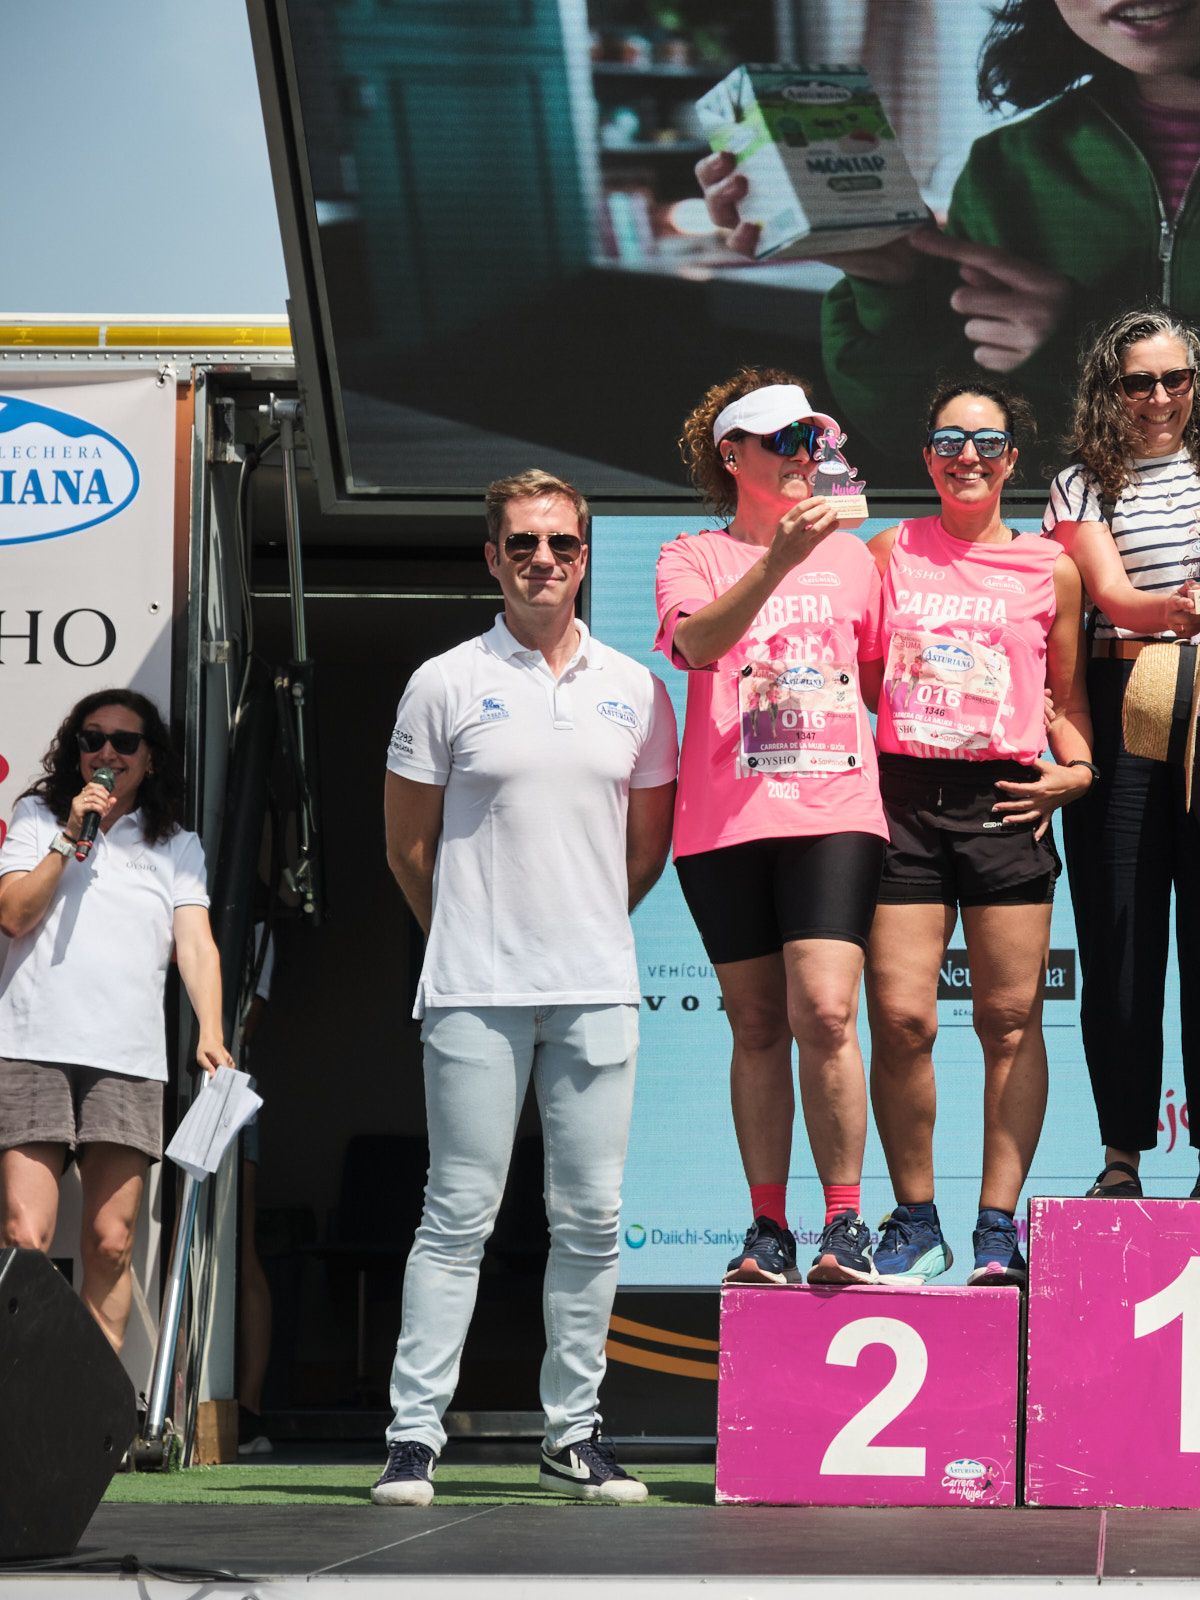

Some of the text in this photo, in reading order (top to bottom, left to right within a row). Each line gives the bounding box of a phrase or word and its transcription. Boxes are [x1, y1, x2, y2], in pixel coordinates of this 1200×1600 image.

[916, 685, 961, 708] 016
[925, 706, 945, 717] 1346
[781, 709, 827, 728] 016
[796, 732, 816, 740] 1347
[760, 743, 788, 751] CARRERA
[757, 755, 796, 766] OYSHO
[767, 781, 800, 799] 2026
[819, 1316, 928, 1477] 2
[941, 1476, 975, 1487] Carrera
